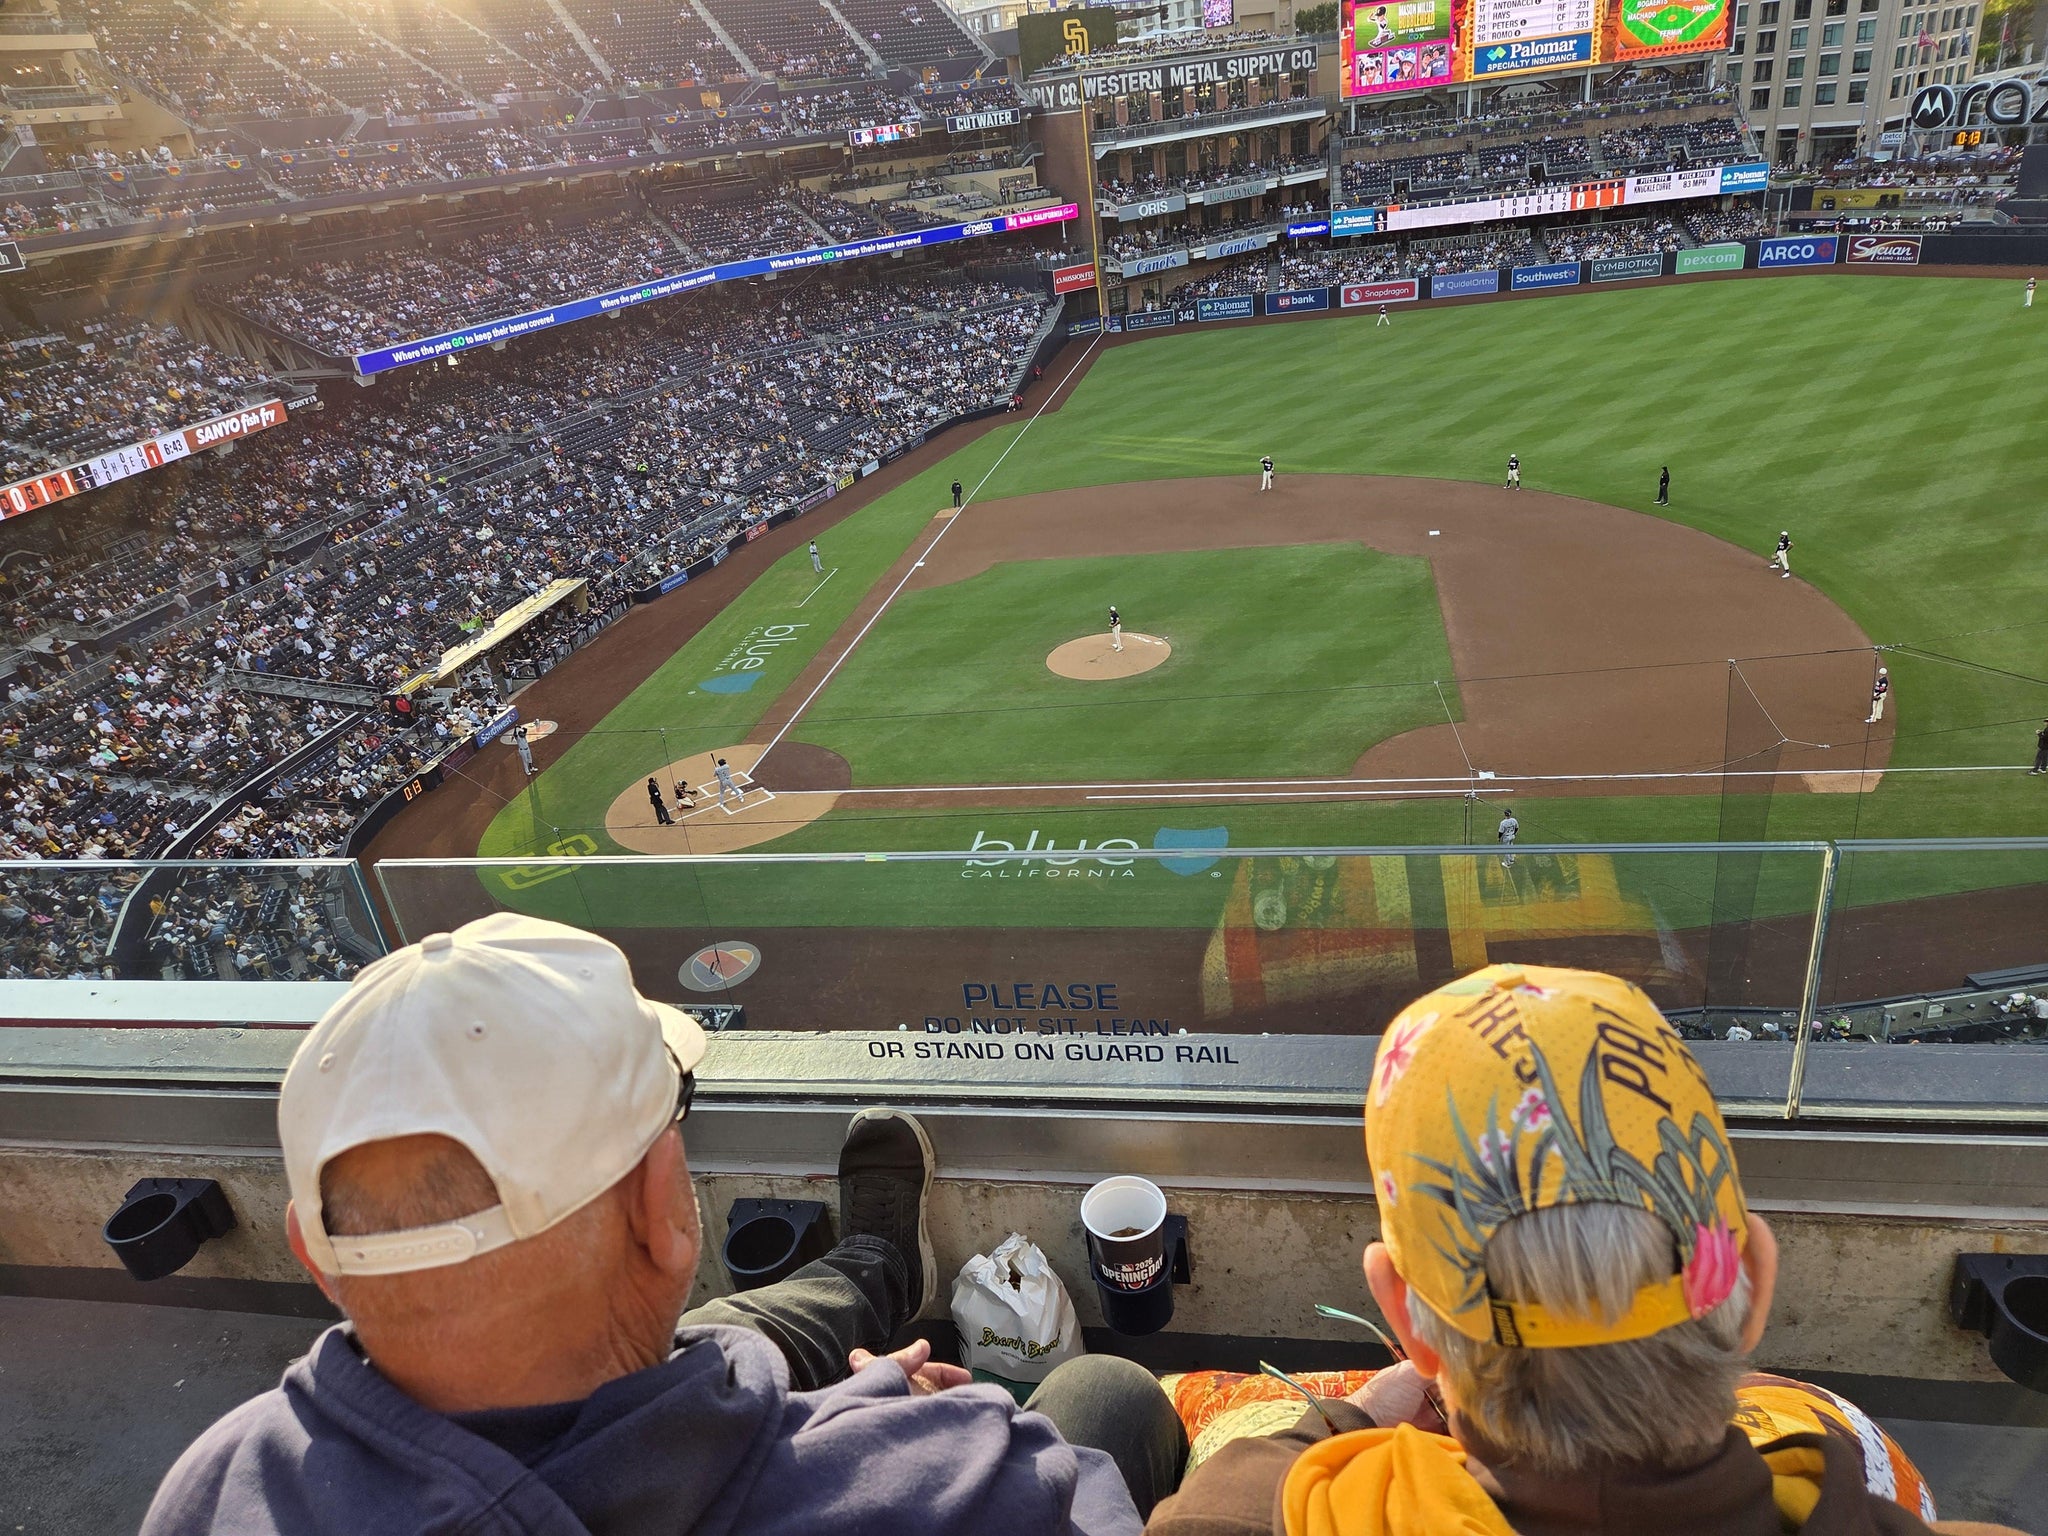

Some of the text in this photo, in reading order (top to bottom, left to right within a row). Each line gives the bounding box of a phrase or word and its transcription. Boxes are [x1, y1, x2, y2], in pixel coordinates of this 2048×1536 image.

[1492, 11, 1510, 20] HAYS
[1557, 3, 1566, 12] RF
[1576, 0, 1589, 10] .231
[1627, 12, 1656, 21] MACHADO
[1692, 3, 1717, 12] FRANCE
[1476, 20, 1589, 42] 36 ROMO C .333
[1477, 11, 1589, 32] 29 PETERS CF .273
[1408, 32, 1424, 40] COX
[1510, 38, 1578, 59] Palomar
[1487, 52, 1578, 72] SPECIALTY INSURANCE
[1083, 49, 1316, 98] WESTERN METAL SUPPLY CO.
[1059, 82, 1082, 107] CO.
[956, 112, 1012, 130] CUTWATER
[1956, 130, 1982, 145] 0:13
[1734, 170, 1767, 180] Palomar
[1833, 163, 1852, 171] petco
[1634, 184, 1656, 193] KNUCKLE
[1656, 182, 1672, 191] CURVE
[1692, 178, 1707, 187] MPH
[1576, 188, 1618, 208] 0 1 1
[1033, 210, 1062, 222] CALIFORNIA
[1138, 200, 1168, 218] ORIS
[1343, 215, 1372, 224] Palomar
[1290, 224, 1322, 235] Southwest
[770, 260, 794, 269] Where
[794, 256, 806, 264] the
[806, 254, 822, 264] pets
[822, 250, 834, 260] GO
[843, 248, 860, 258] keep
[860, 245, 876, 254] their
[876, 242, 896, 251] bases
[896, 236, 922, 247] covered
[1218, 238, 1258, 256] Canel's
[1762, 244, 1815, 262] ARCO
[1852, 238, 1912, 261] Sycuan
[1136, 256, 1177, 274] Canel's
[1594, 258, 1660, 272] CYMBIOTIKA
[1062, 274, 1084, 284] MISSION
[1106, 274, 1122, 287] 336
[1447, 278, 1495, 290] QuidelOrtho
[1516, 269, 1568, 284] Southwest
[600, 272, 716, 309] Where the pets GO to keep their bases covered
[1278, 294, 1316, 306] us bank
[1365, 286, 1409, 299] Snapdragon
[1213, 300, 1250, 310] Palomar
[1178, 309, 1195, 322] 342
[392, 313, 555, 362] Where the pets GO to keep their bases covered
[195, 407, 276, 445] SANYO fish fry
[92, 439, 184, 480] R H E 1 6:43
[100, 446, 143, 470] 0 0 0
[106, 458, 148, 482] 0 0 0
[9, 487, 27, 512] 0
[36, 480, 51, 503] 1
[60, 471, 76, 494] 1
[712, 626, 764, 672] CALIFORNIA
[731, 624, 810, 670] blue
[480, 715, 512, 744] Southwest
[965, 830, 1140, 866] blue
[961, 869, 1136, 878] CALIFORNIA
[962, 982, 1120, 1012] PLEASE
[924, 1016, 1170, 1039] DO NOT SIT, LEAN
[868, 1041, 1240, 1064] OR STAND ON GUARD RAIL
[1102, 1254, 1163, 1282] OPENING DAY
[1135, 1256, 1153, 1270] 2026
[1027, 1327, 1061, 1359] Brew
